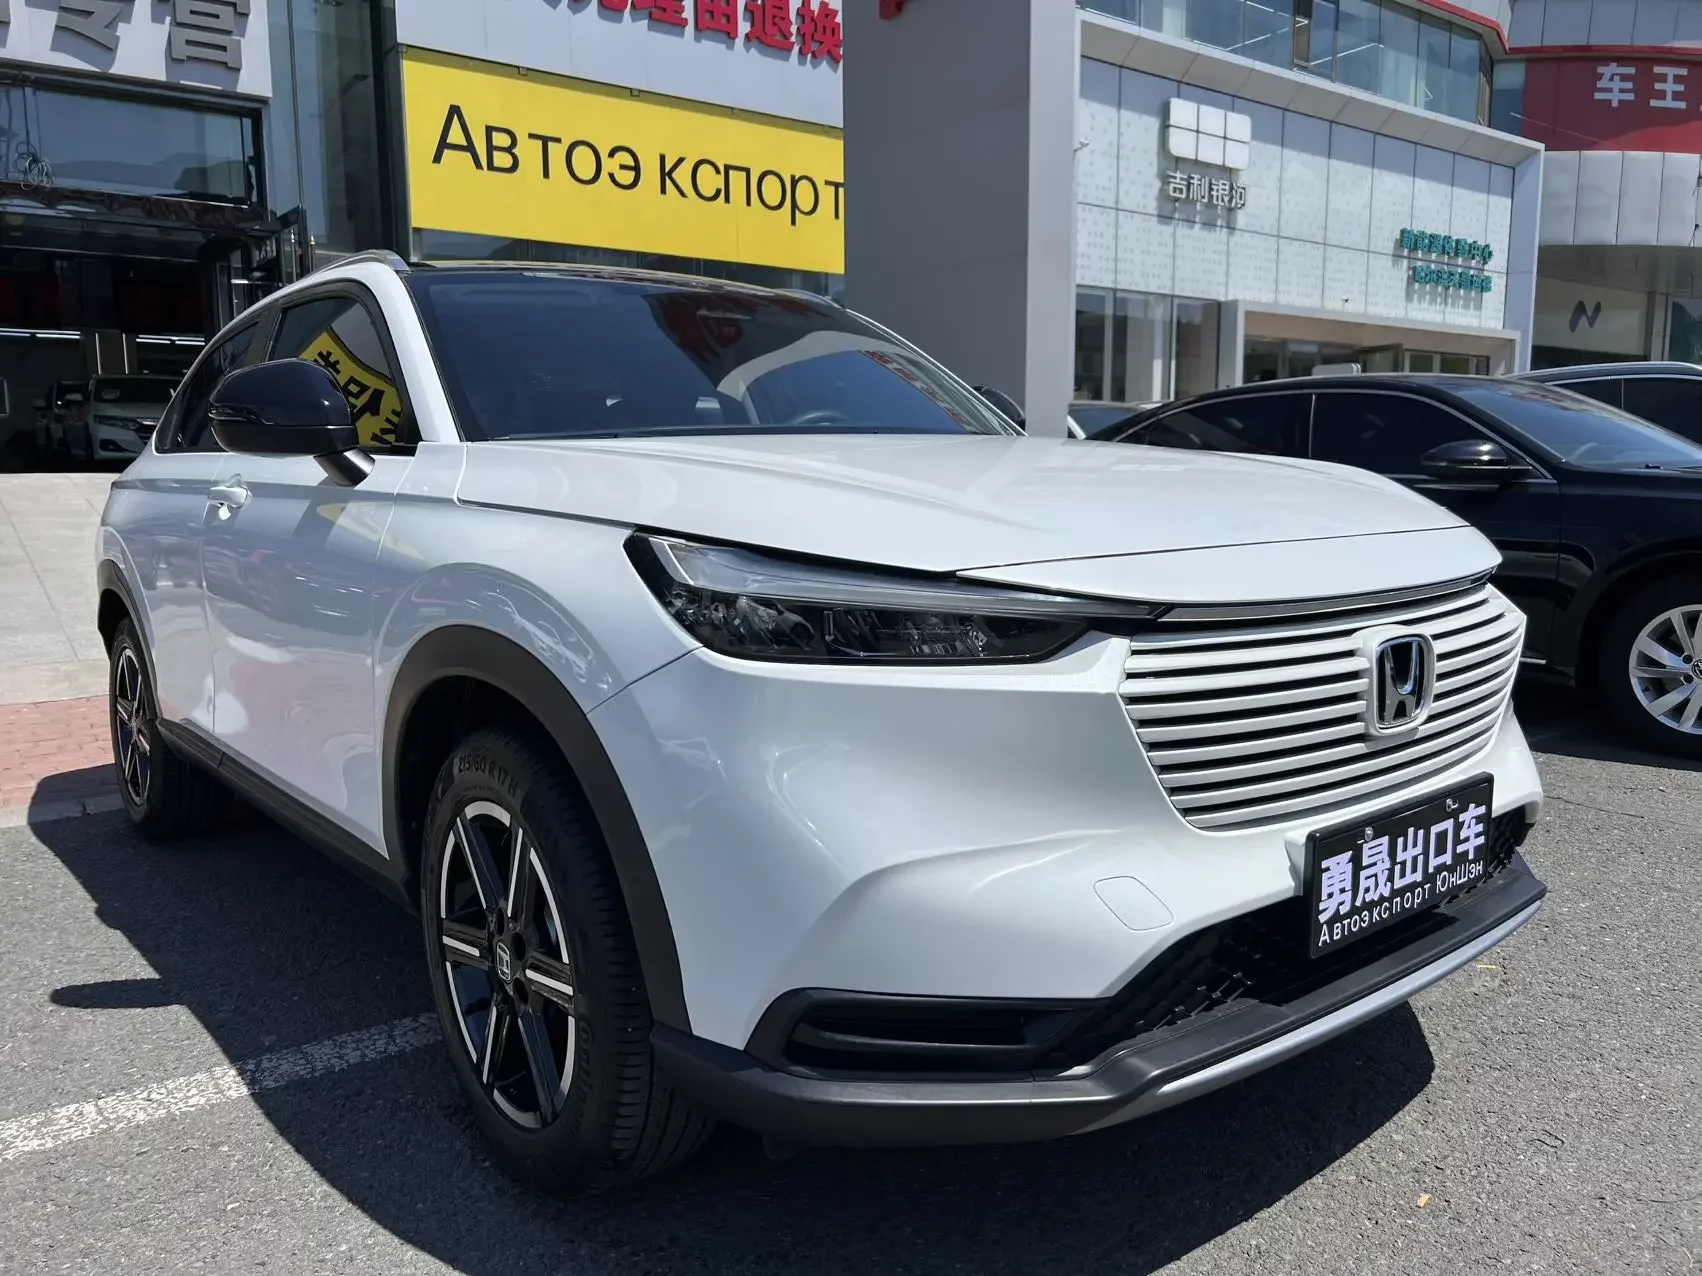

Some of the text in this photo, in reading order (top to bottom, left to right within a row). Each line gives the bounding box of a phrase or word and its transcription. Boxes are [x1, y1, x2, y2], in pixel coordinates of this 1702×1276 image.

[1166, 170, 1247, 209] 吉利银河
[1318, 803, 1487, 924] 勇晟出口车
